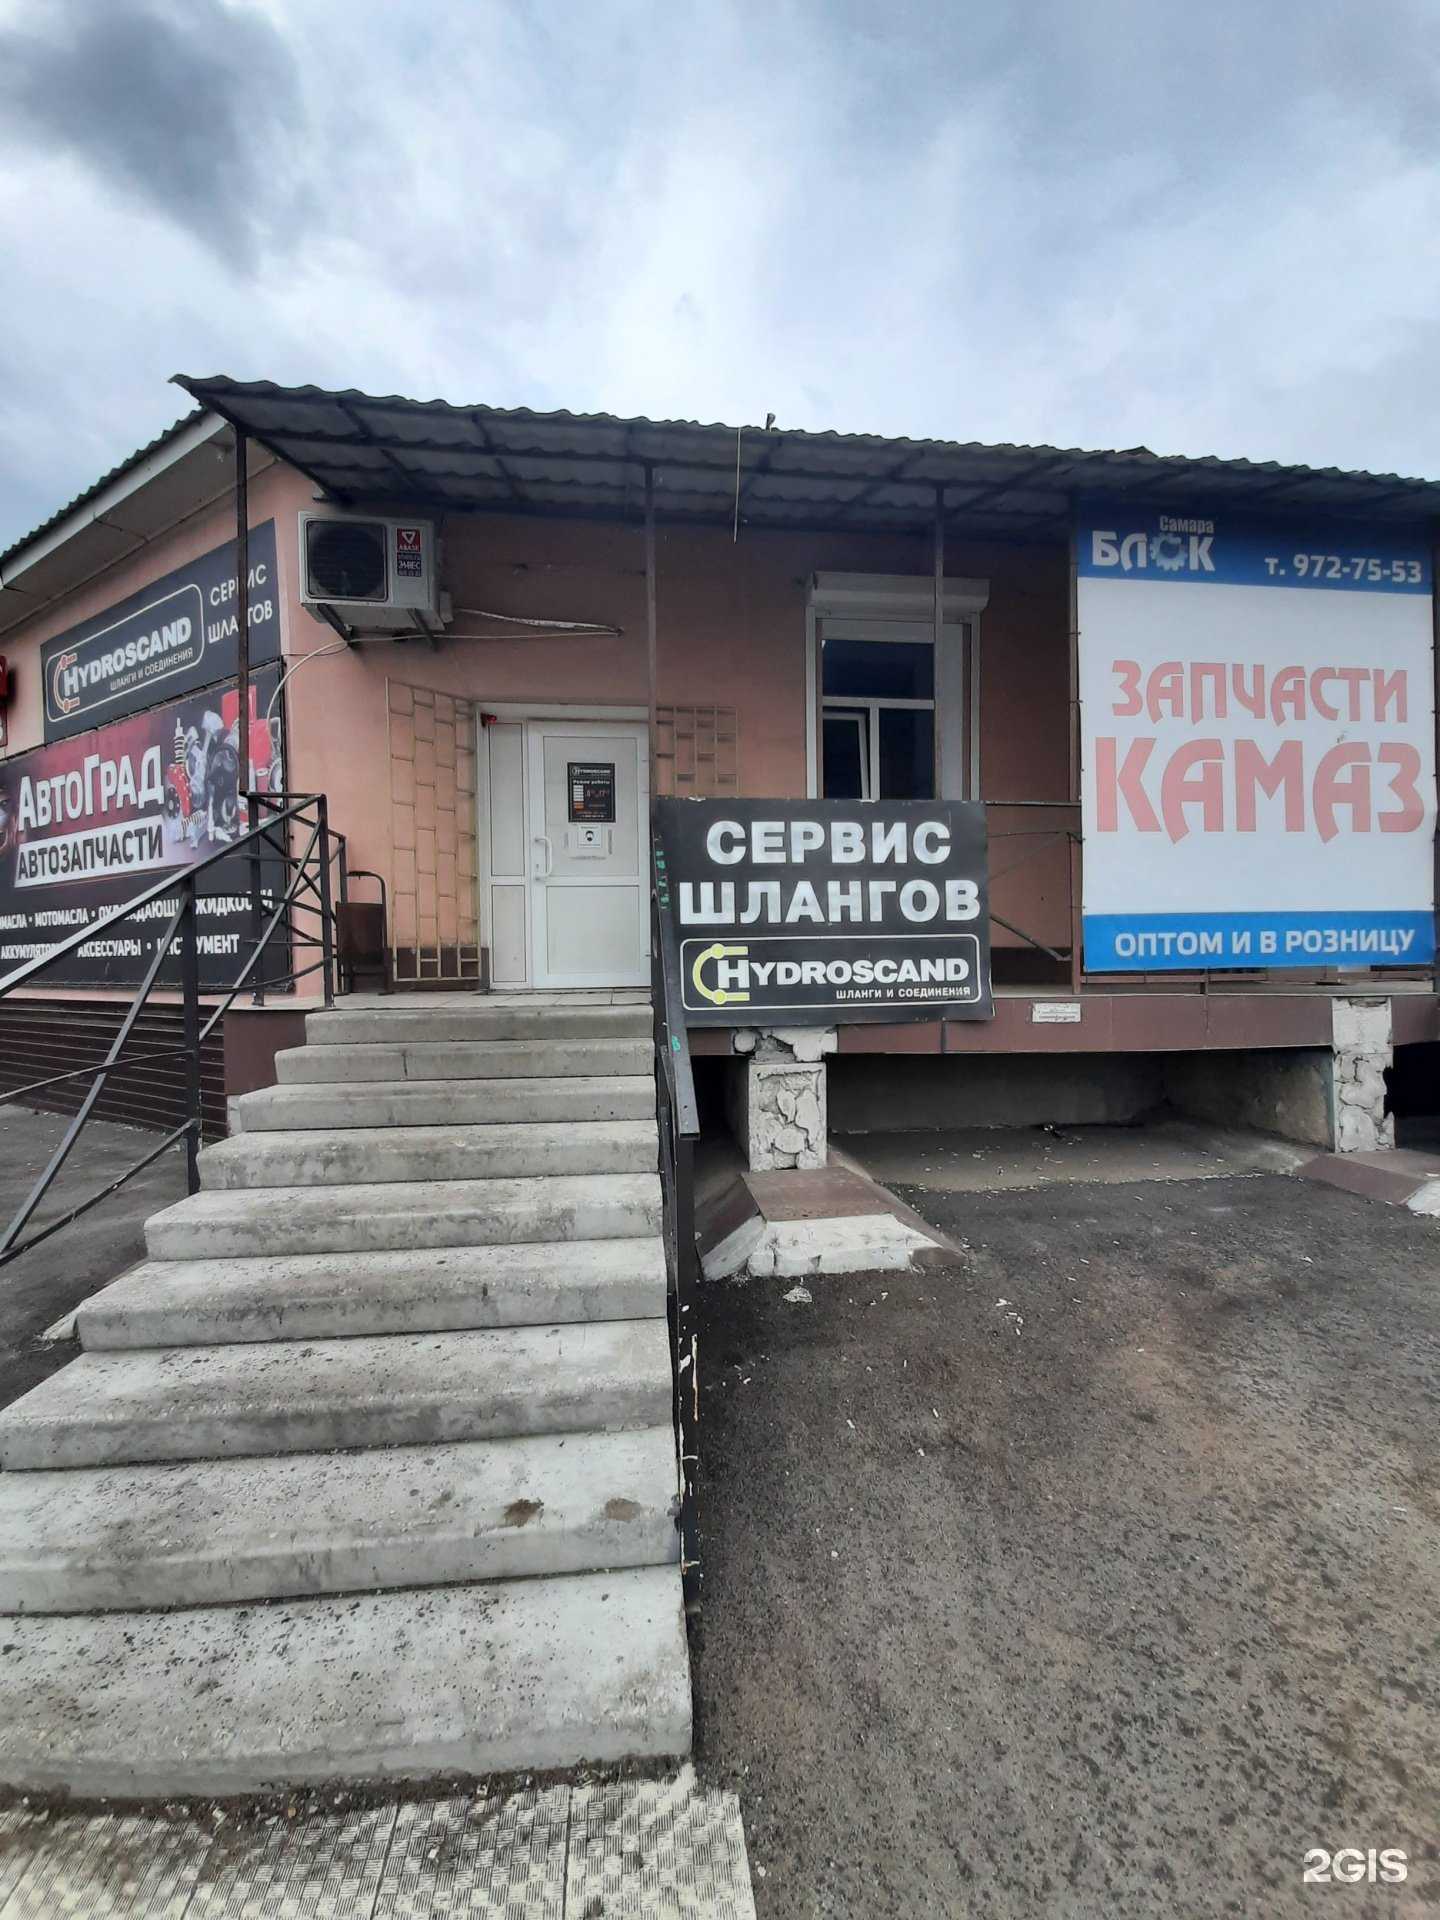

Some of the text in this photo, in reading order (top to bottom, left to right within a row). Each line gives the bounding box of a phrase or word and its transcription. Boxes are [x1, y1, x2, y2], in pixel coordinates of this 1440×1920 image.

[1159, 515, 1215, 534] Самара
[1092, 530, 1216, 571] БЛОК
[1264, 554, 1422, 584] т. 972-75-53
[210, 564, 267, 606] СЕРИС
[208, 600, 273, 644] ШЛАГОВ
[63, 616, 192, 697] HYDROSCAND
[110, 646, 194, 692] ШЛАНГИ И СОЕДИНЕНИЯ
[1111, 659, 1408, 726] ЗАПЧАСТИ
[1095, 736, 1424, 844] КАМАЗ
[18, 824, 164, 881] АВТОЗАПЧАСТИ
[707, 820, 951, 865] СЕРВИС
[0, 913, 28, 930] МАСЛА
[35, 907, 89, 927] МОТОМАСЛА
[679, 879, 981, 924] ШЛАНГОВ
[77, 938, 142, 958] АКСЕССУАРЫ
[1115, 929, 1415, 957] ОПТОМ И В РОЗНИЦУ
[717, 957, 969, 989] HYDROSCAND
[836, 986, 971, 999] ШЛАНГИ И СОЕДИНЕНИЯ
